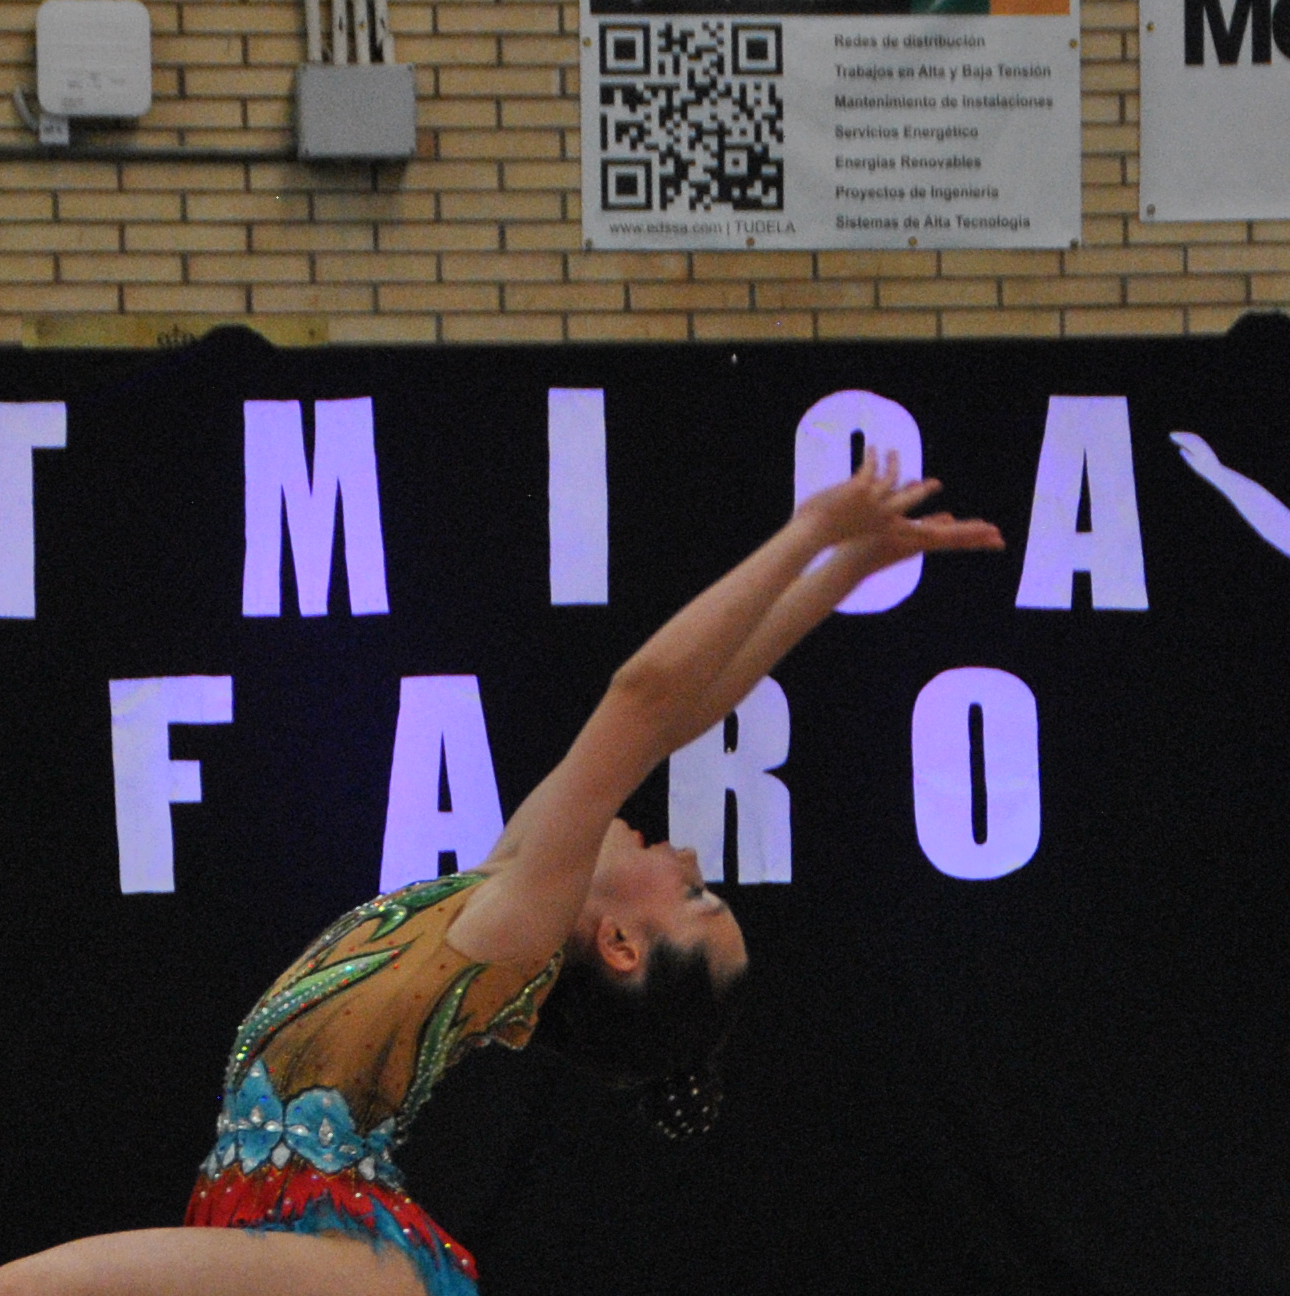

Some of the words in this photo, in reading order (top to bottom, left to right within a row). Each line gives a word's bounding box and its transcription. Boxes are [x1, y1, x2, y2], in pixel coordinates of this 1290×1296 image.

[834, 34, 877, 48] Redes
[882, 34, 899, 48] de
[834, 64, 894, 82] Trabajos
[898, 67, 915, 78] en
[918, 64, 946, 78] Alta
[949, 67, 958, 82] y
[962, 64, 993, 82] Baja
[834, 95, 937, 109] Mantenimiento
[941, 95, 958, 109] de
[962, 94, 1054, 108] Instalaciones
[834, 125, 899, 139] Servicios
[901, 155, 982, 169] Renovables
[834, 186, 906, 202] Proyectos
[910, 185, 927, 199] de
[735, 220, 796, 234] TUDELA
[835, 215, 899, 230] Sistemas
[903, 215, 920, 229] de
[924, 215, 951, 229] Alta
